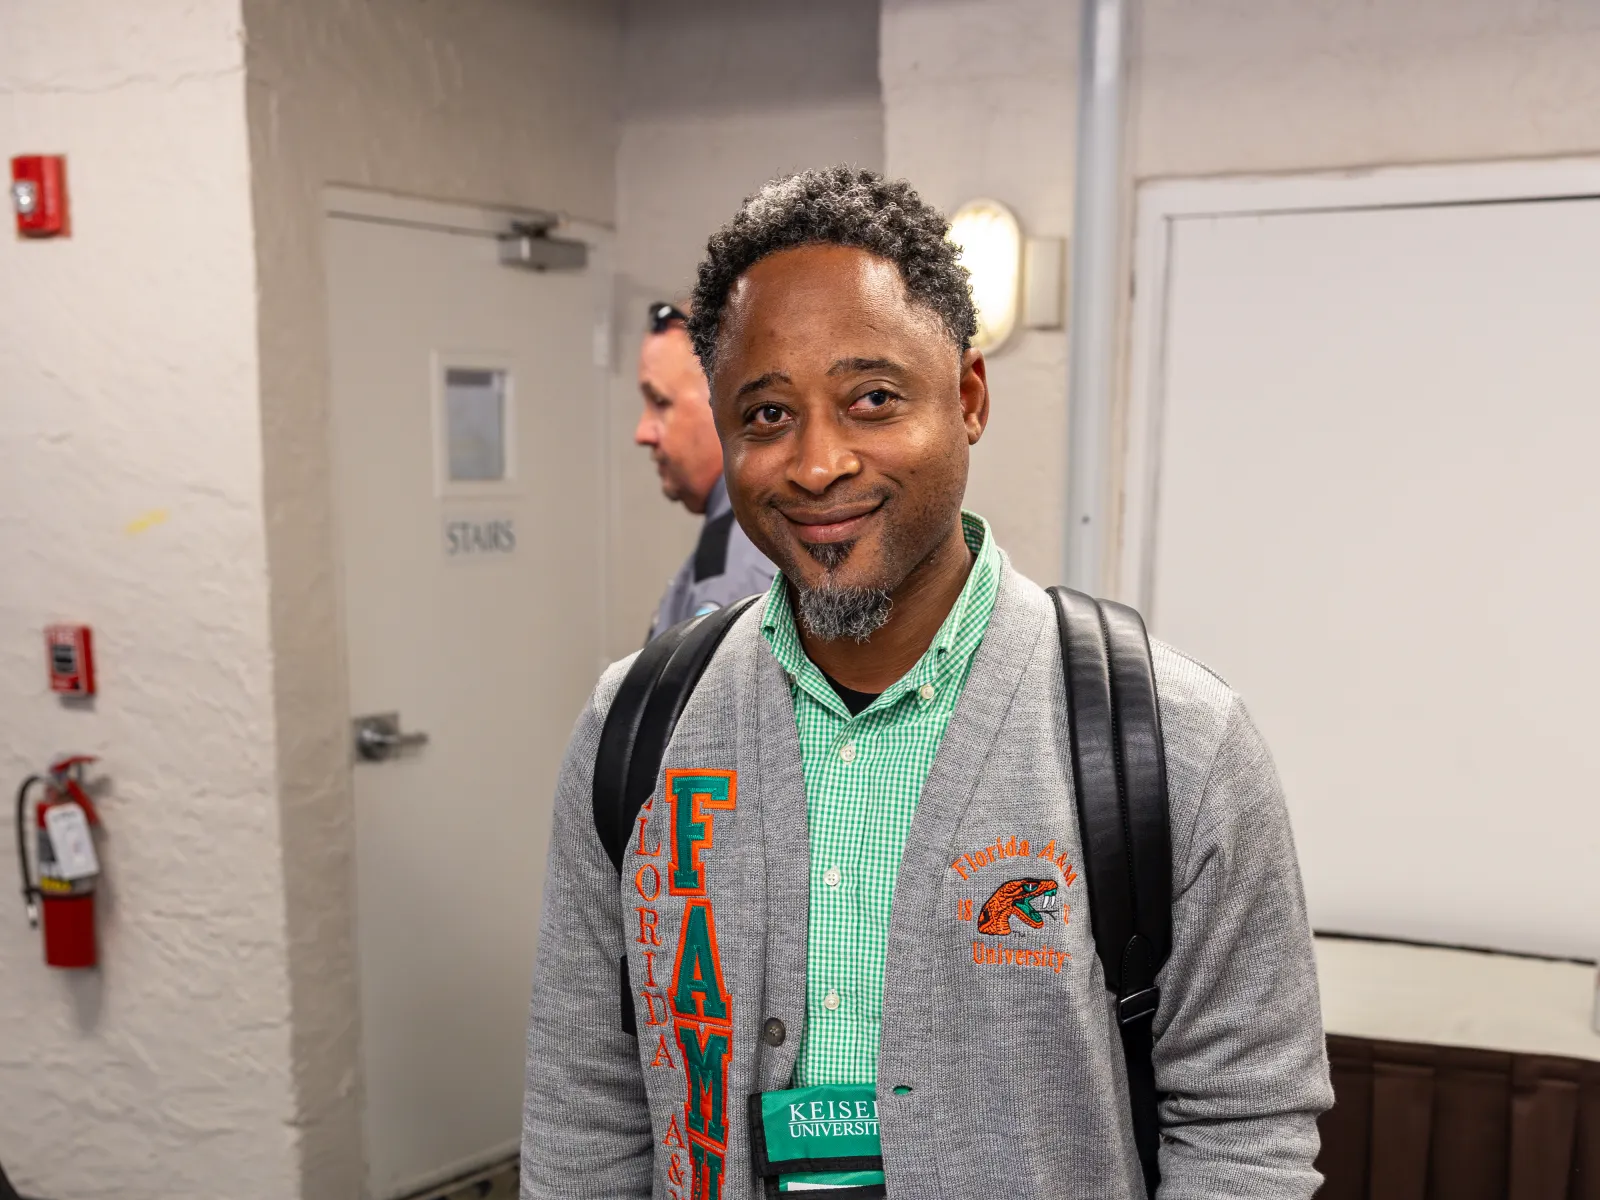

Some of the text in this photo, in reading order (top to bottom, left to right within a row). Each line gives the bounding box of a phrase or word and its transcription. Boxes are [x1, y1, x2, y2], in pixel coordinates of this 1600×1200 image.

[446, 519, 517, 556] STAIRS
[951, 835, 1079, 888] Florida A&M
[635, 798, 677, 1070] LORIDA
[972, 942, 1066, 974] University
[789, 1121, 880, 1138] UNIVERSIT
